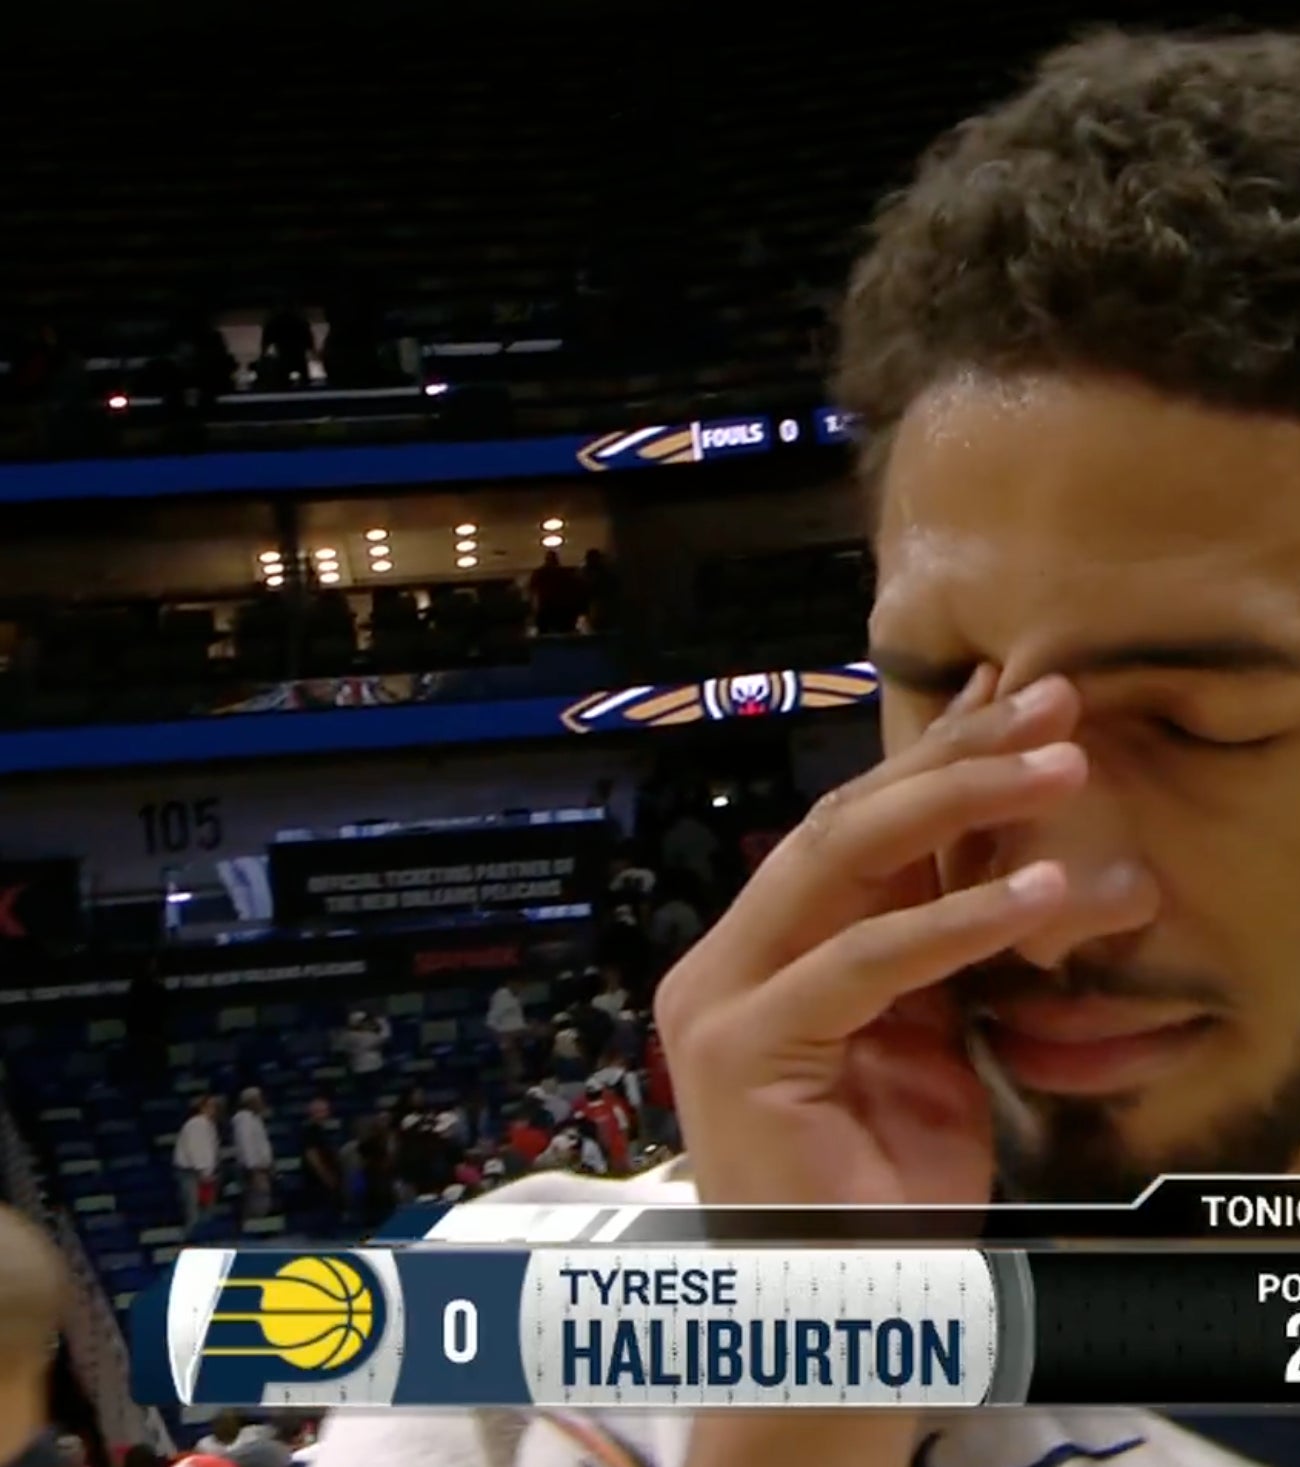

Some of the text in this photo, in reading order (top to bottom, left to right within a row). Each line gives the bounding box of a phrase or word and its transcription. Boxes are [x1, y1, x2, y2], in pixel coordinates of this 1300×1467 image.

[702, 422, 764, 448] FOULS
[779, 418, 799, 443] 0
[139, 798, 222, 853] 105
